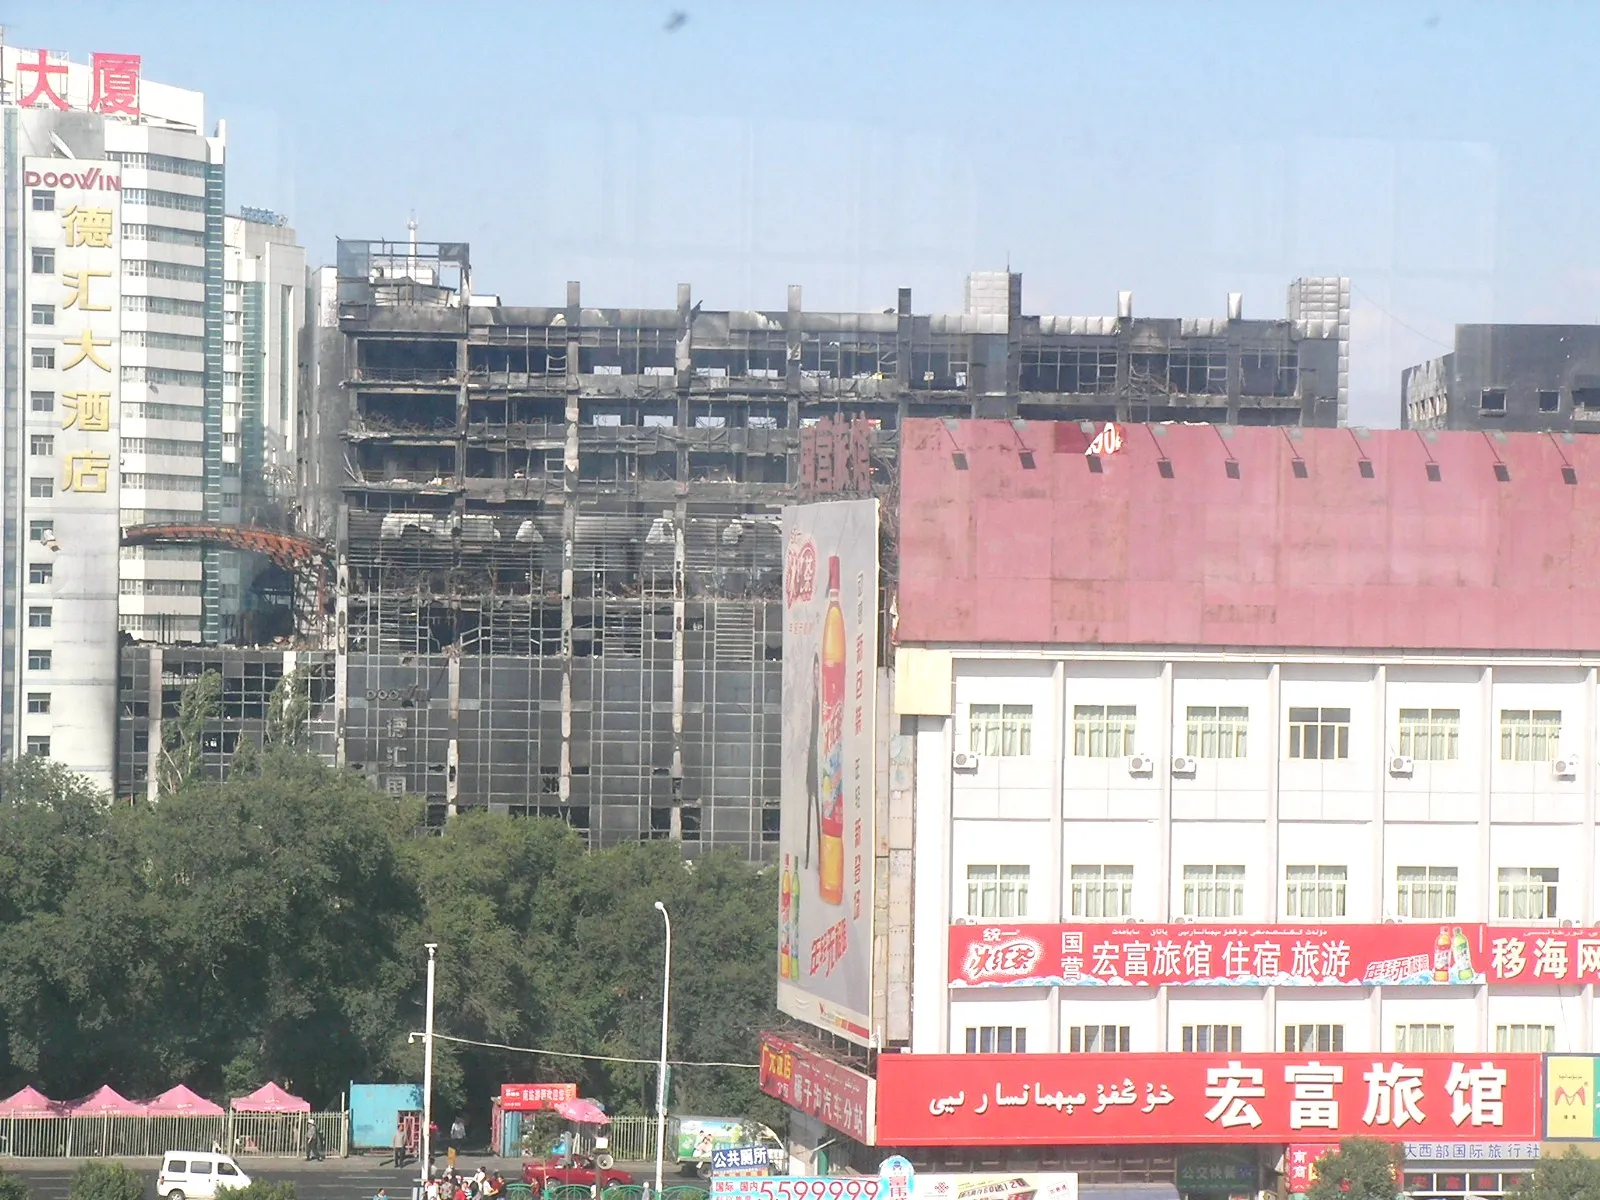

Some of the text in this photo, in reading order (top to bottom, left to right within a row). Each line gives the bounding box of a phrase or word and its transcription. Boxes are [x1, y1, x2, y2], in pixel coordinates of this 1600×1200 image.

[17, 49, 141, 115] 大厦
[24, 167, 121, 191] DOOWIN
[62, 204, 112, 493] 德汇大酒店
[983, 928, 1018, 941] 统一
[1092, 940, 1350, 977] 宏富旅馆 住宿 旅游
[1204, 1061, 1507, 1128] 宏富旅馆
[713, 1147, 767, 1168] 公共厕所
